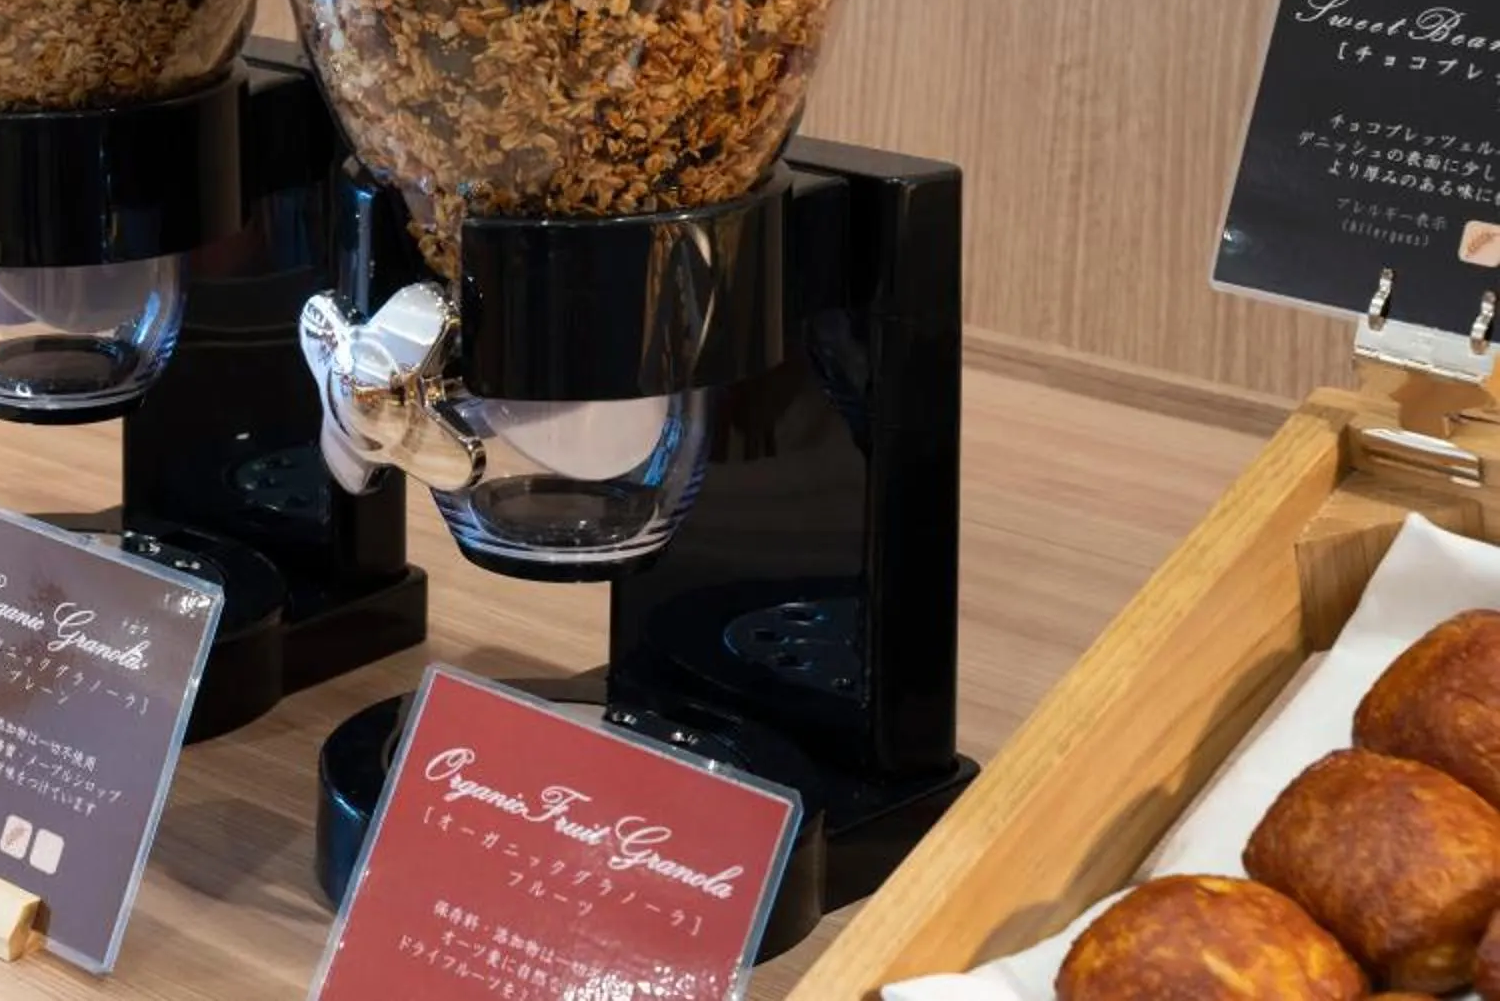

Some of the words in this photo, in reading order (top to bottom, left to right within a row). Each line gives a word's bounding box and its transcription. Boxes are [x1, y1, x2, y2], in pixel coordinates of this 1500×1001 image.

[47, 602, 152, 671] Granola
[425, 747, 528, 815] Organic
[523, 785, 611, 846] Fruit
[607, 815, 744, 900] Granola
[507, 870, 594, 917] フルーツ
